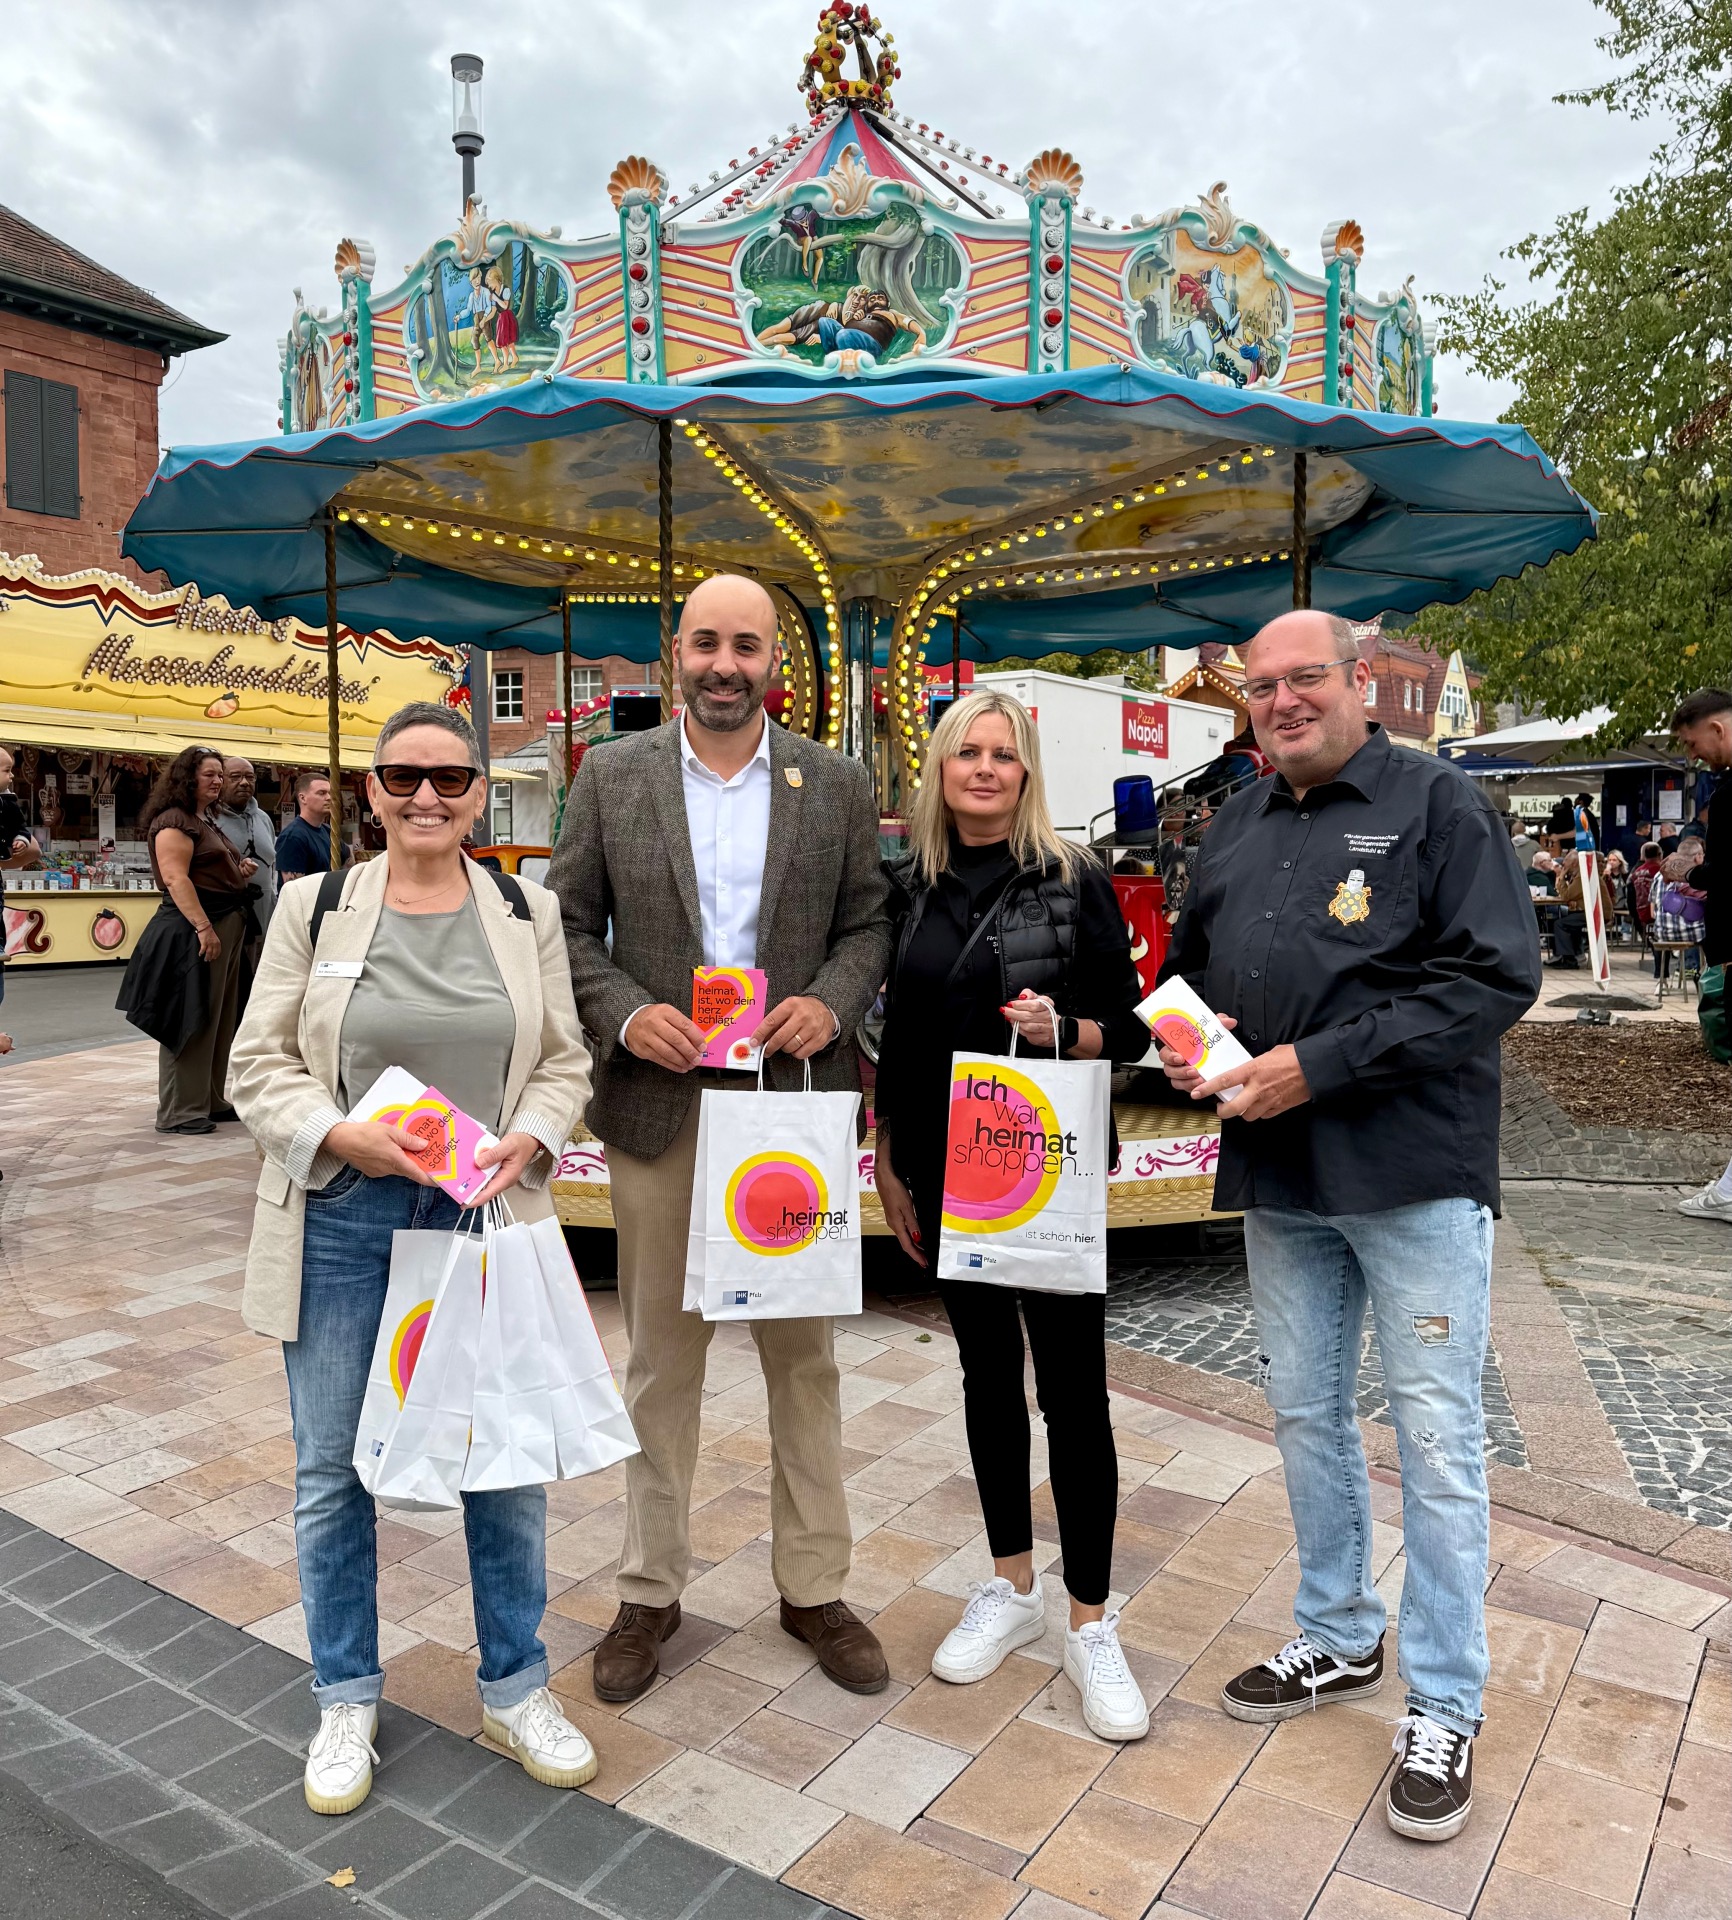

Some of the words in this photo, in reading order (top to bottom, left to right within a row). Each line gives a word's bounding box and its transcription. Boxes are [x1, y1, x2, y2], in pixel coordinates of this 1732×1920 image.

[1137, 707, 1155, 725] Pizza
[1128, 718, 1163, 747] Napoli
[697, 996, 713, 1005] ist,
[733, 996, 756, 1005] dein
[698, 986, 735, 996] heimat
[697, 1005, 721, 1014] herz
[697, 1015, 737, 1026] schlägt.
[1170, 1020, 1193, 1041] Ganz
[1187, 1027, 1208, 1048] kauf
[1201, 1029, 1225, 1051] lokal.
[966, 1074, 1007, 1102] Ich
[993, 1101, 1047, 1126] war
[411, 1117, 435, 1138] mat
[424, 1127, 439, 1141] wo
[438, 1109, 456, 1127] dein
[974, 1118, 1077, 1156] heimat
[417, 1140, 441, 1163] herz
[428, 1137, 461, 1169] schlägt.
[953, 1138, 1094, 1179] shoppen...
[782, 1206, 848, 1226] heimat
[766, 1220, 849, 1245] shoppen
[1025, 1229, 1040, 1239] ist
[1039, 1231, 1072, 1242] schön
[1074, 1232, 1097, 1244] hier.
[983, 1256, 997, 1264] Pfalz
[736, 1291, 747, 1299] IHK
